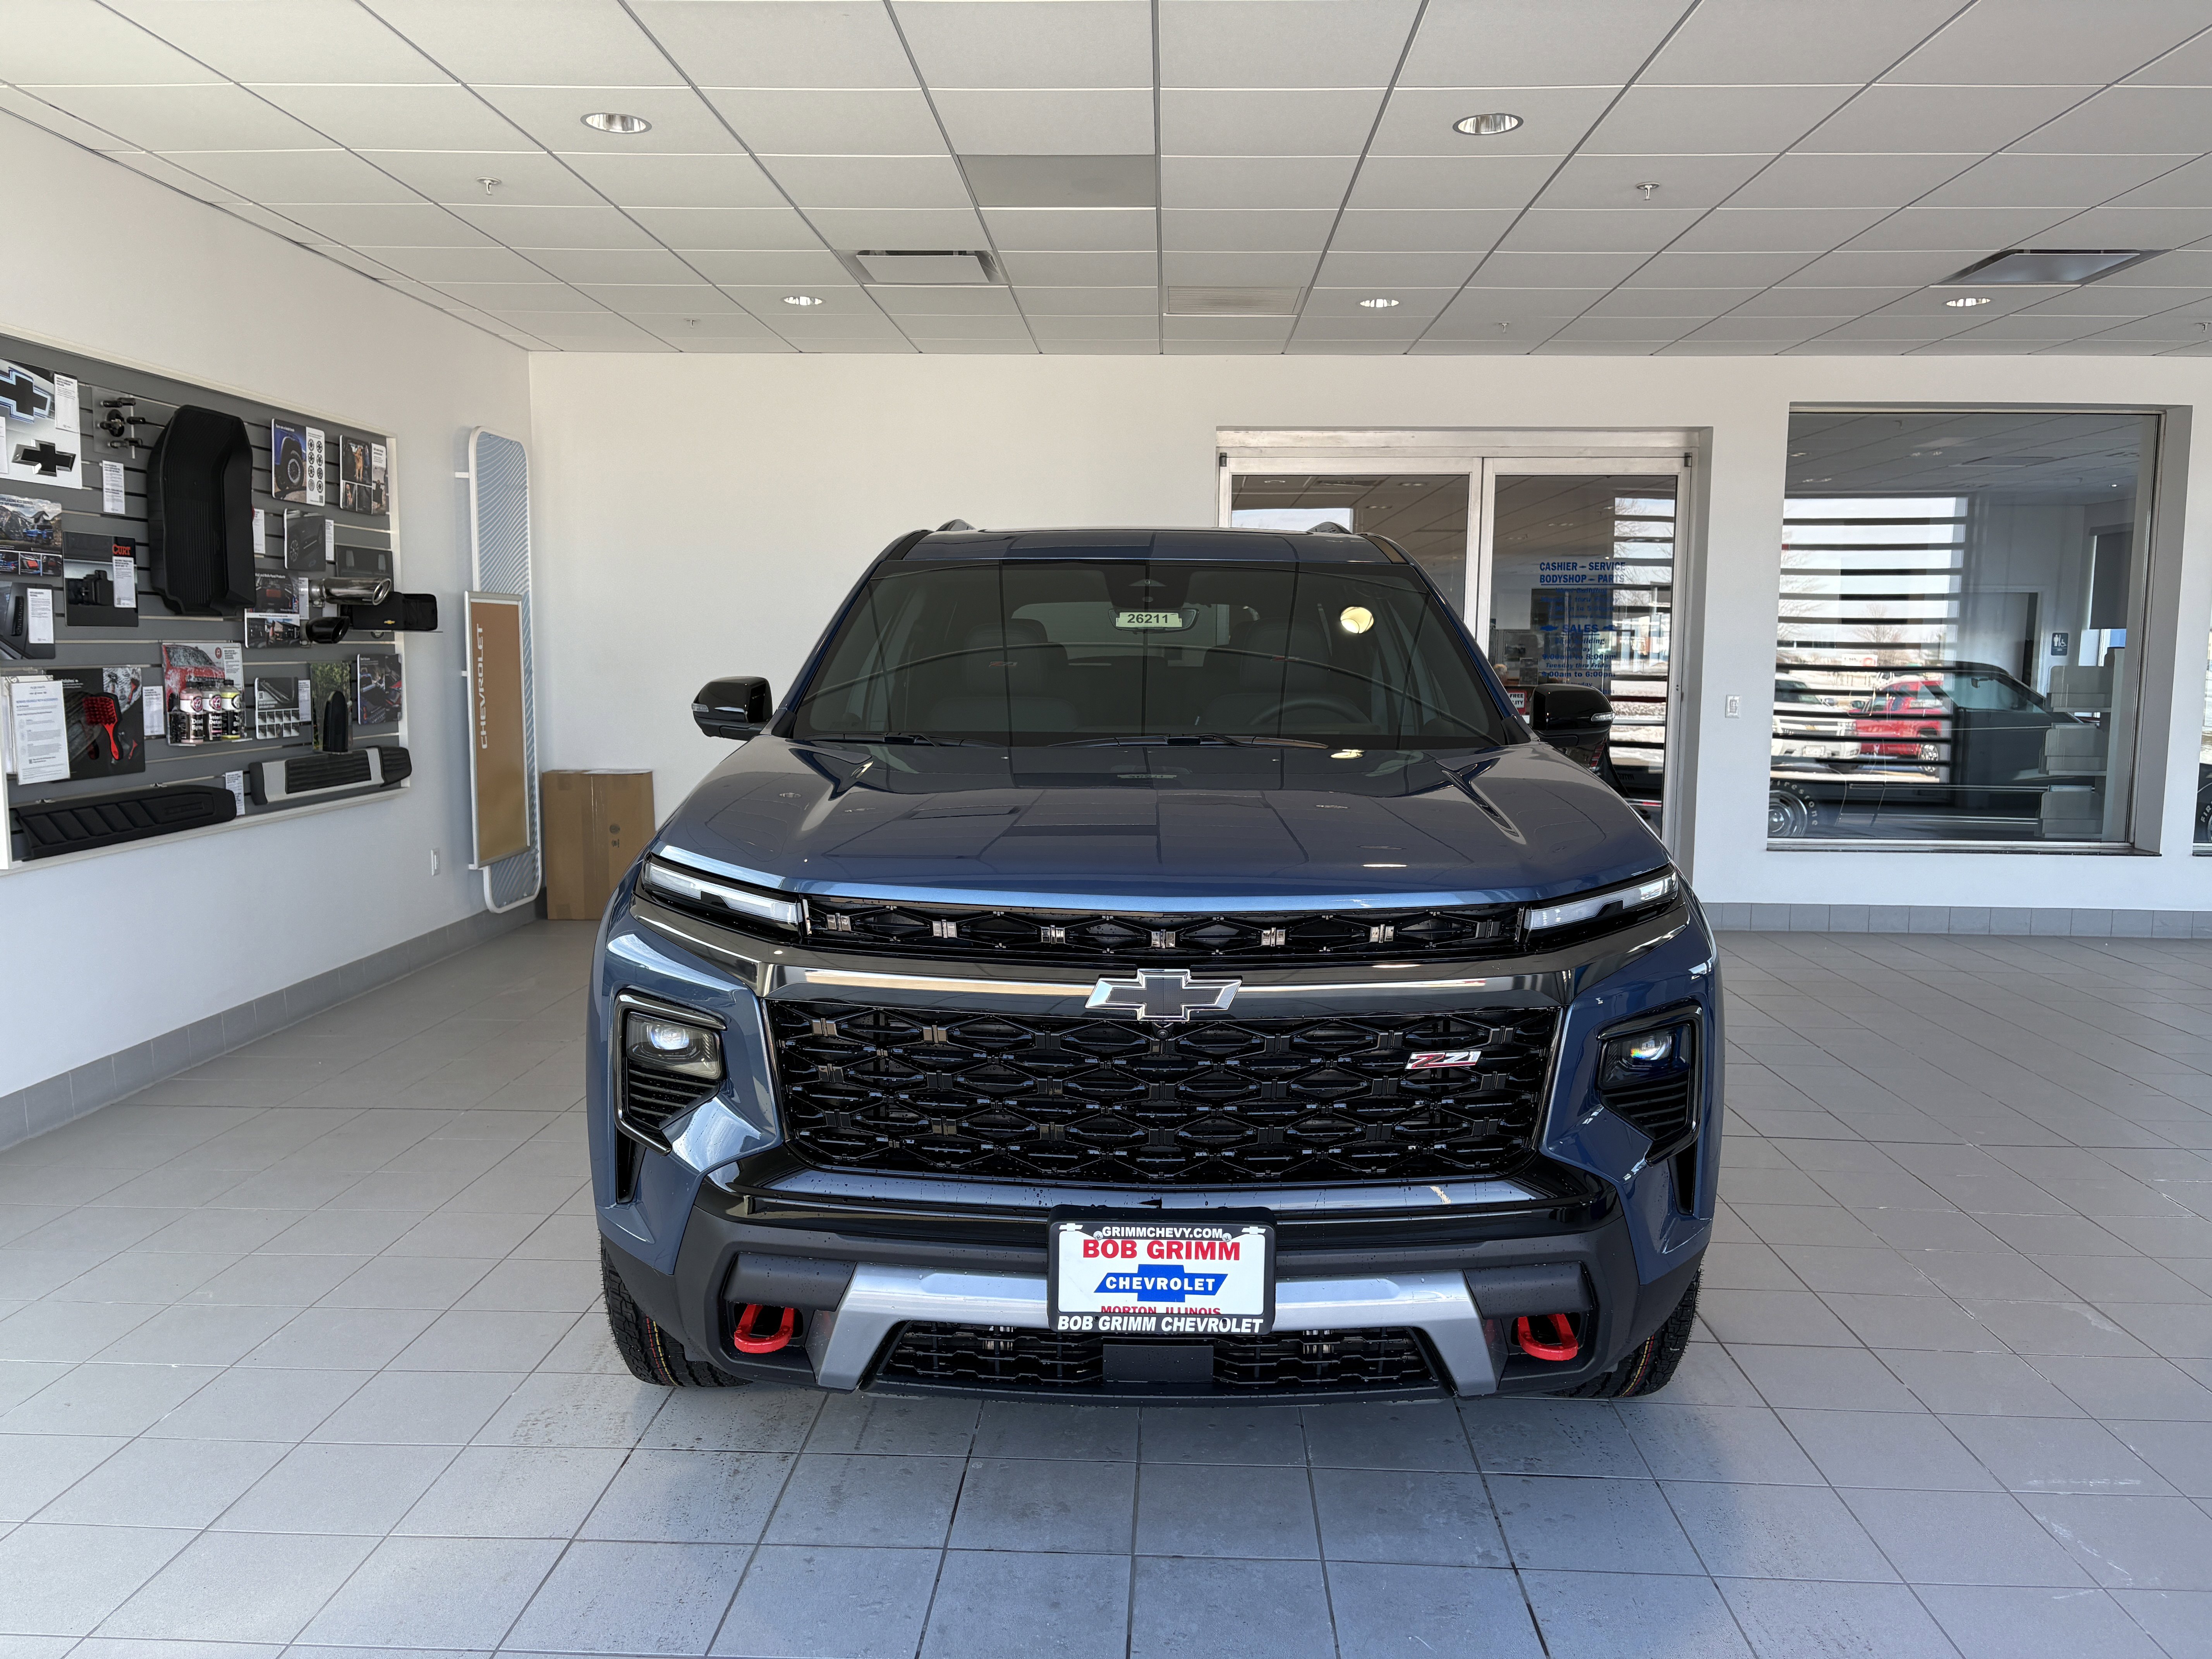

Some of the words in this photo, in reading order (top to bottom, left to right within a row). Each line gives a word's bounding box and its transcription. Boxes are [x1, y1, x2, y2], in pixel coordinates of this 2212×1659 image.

[112, 544, 131, 555] CURT
[1539, 562, 1577, 571] CASHIER
[1588, 562, 1626, 571] SERVICE
[1539, 574, 1587, 584] BODYSHOP
[1597, 574, 1625, 583] PARTS
[1127, 614, 1168, 623] 26211
[1562, 624, 1599, 633] SALES
[477, 623, 488, 749] CHEVROLET
[1406, 1051, 1482, 1070] Z71
[1102, 1226, 1223, 1239] GRIMMCHEVY.COM
[1083, 1239, 1137, 1259] BOB
[1147, 1241, 1240, 1261] GRIMM
[1106, 1276, 1215, 1291] CHEVROLET
[1057, 1315, 1093, 1331] BOB
[1097, 1316, 1156, 1331] GRIMM
[1161, 1317, 1264, 1333] CHEVROLET
